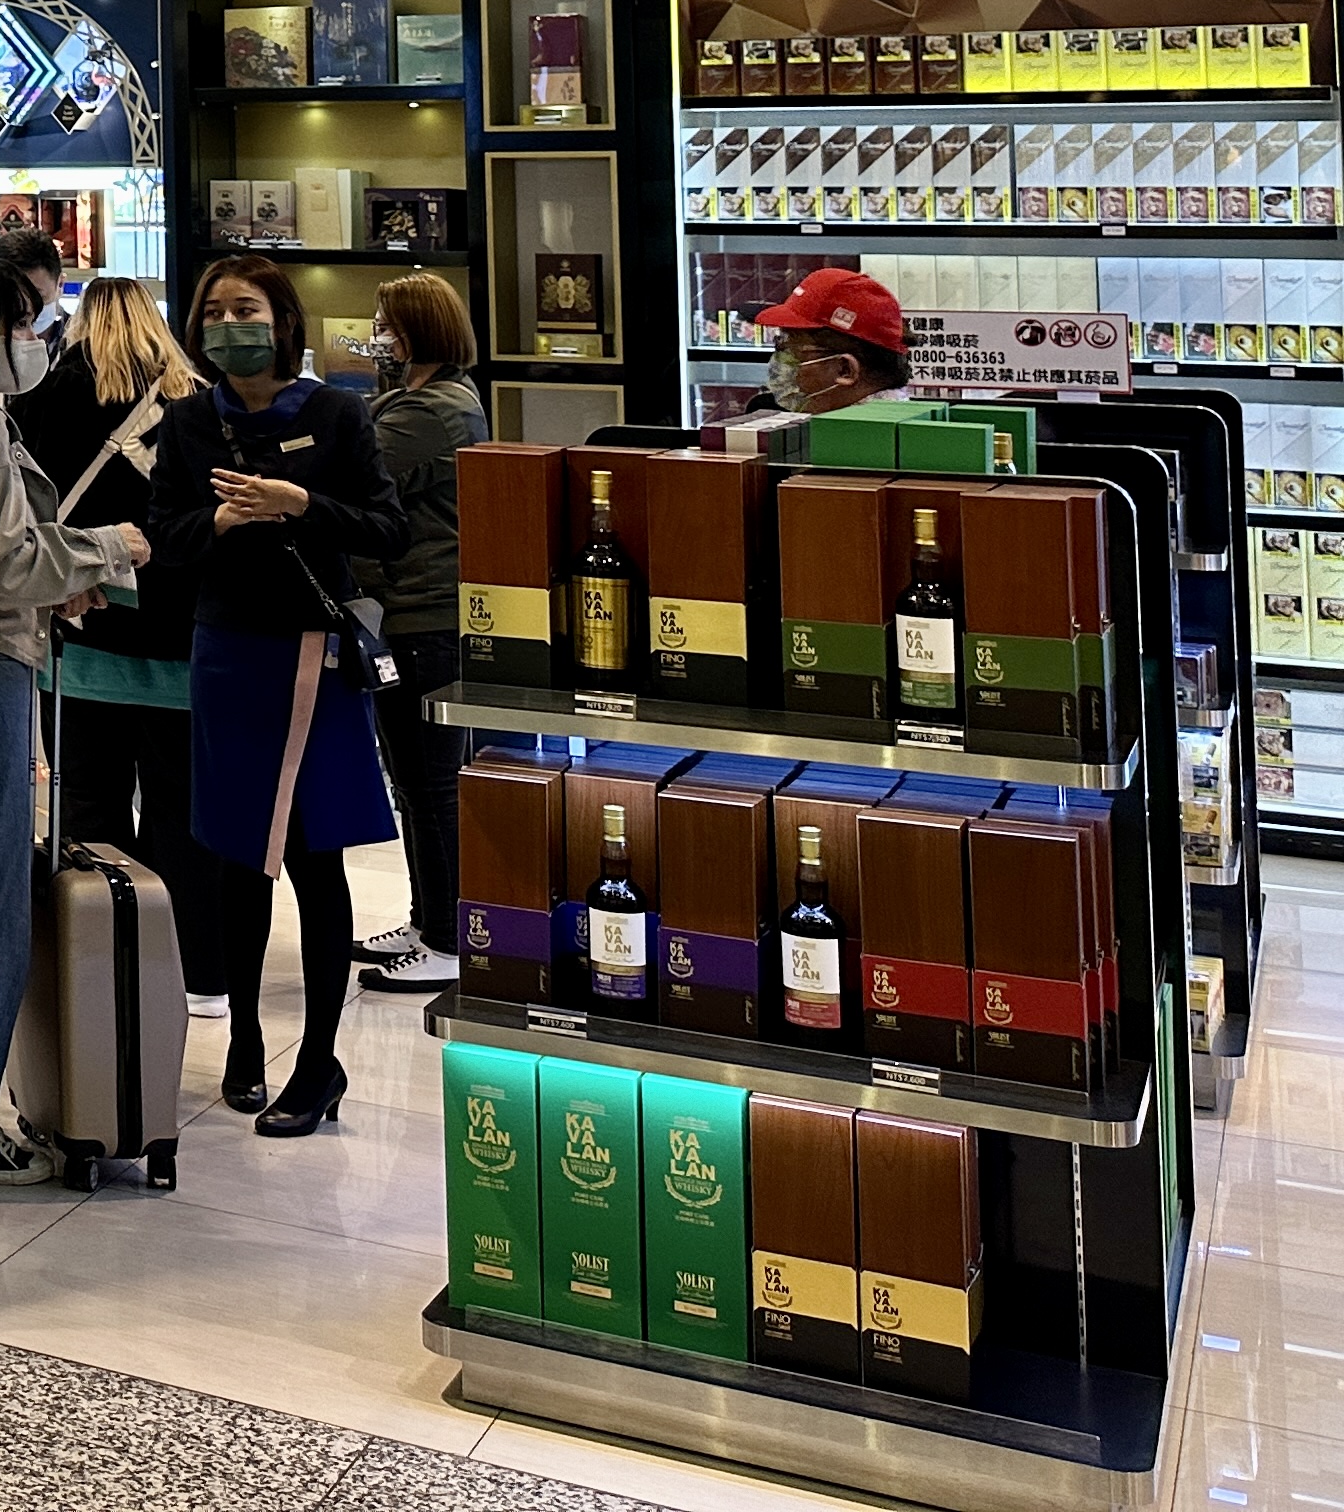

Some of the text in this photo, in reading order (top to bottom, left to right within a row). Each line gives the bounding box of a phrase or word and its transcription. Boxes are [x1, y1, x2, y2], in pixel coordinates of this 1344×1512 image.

[909, 365, 1119, 385] 不得吸菸及禁止供應其菸品
[469, 638, 493, 648] FINO
[660, 653, 685, 664] FINO
[467, 1096, 496, 1116] KA
[468, 1111, 497, 1130] VA
[566, 1112, 595, 1132] KA
[468, 1125, 510, 1147] LAN
[566, 1128, 596, 1146] VA
[670, 1129, 700, 1149] KA
[472, 1147, 507, 1160] WHISKY
[566, 1141, 610, 1163] LAN
[671, 1144, 700, 1163] VA
[571, 1164, 607, 1178] WHISKY
[670, 1159, 716, 1181] LAN
[675, 1181, 713, 1196] WHISKY
[474, 1234, 510, 1253] SOLIST
[572, 1251, 609, 1272] SOLIST
[676, 1271, 715, 1292] SOLIST
[764, 1311, 791, 1325] FINO
[873, 1333, 900, 1347] FINO
